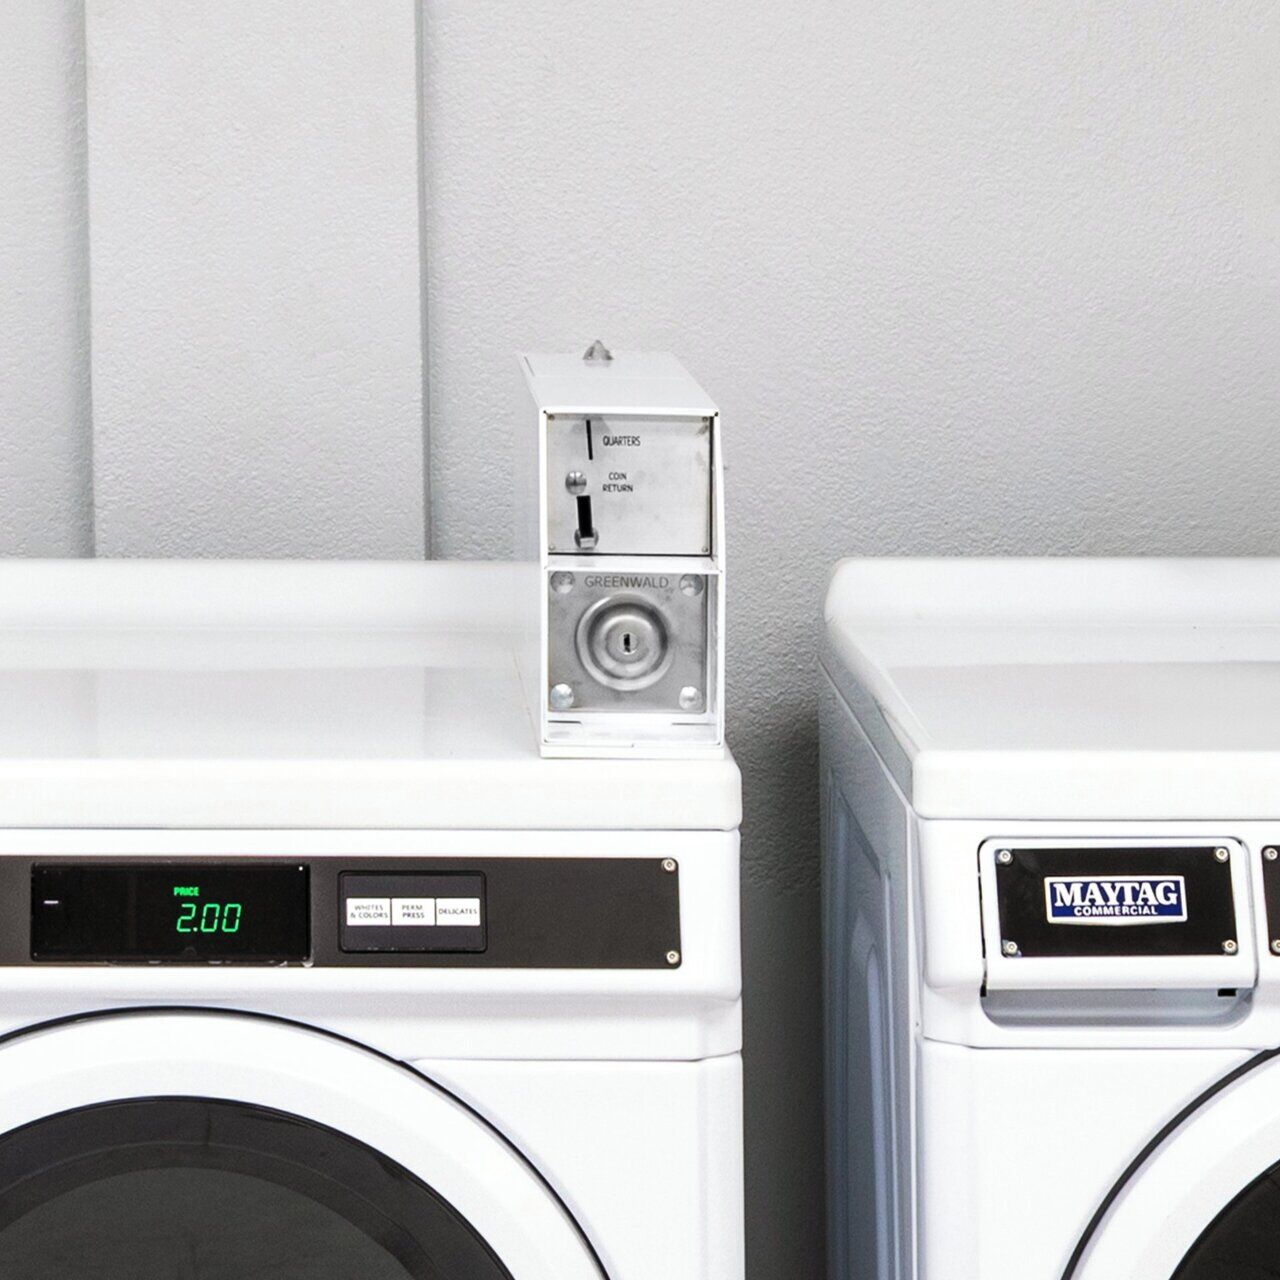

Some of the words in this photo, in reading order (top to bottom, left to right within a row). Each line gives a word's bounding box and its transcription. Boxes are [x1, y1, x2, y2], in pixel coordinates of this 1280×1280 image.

[602, 435, 641, 447] QUARTERS
[608, 471, 627, 481] COIN
[602, 484, 634, 493] RETURN
[584, 574, 670, 589] GREENWALD
[173, 886, 200, 897] PRICE
[1053, 881, 1179, 908] MAYTAG
[1073, 905, 1159, 917] COMMERCIAL
[176, 903, 243, 933] 2.00
